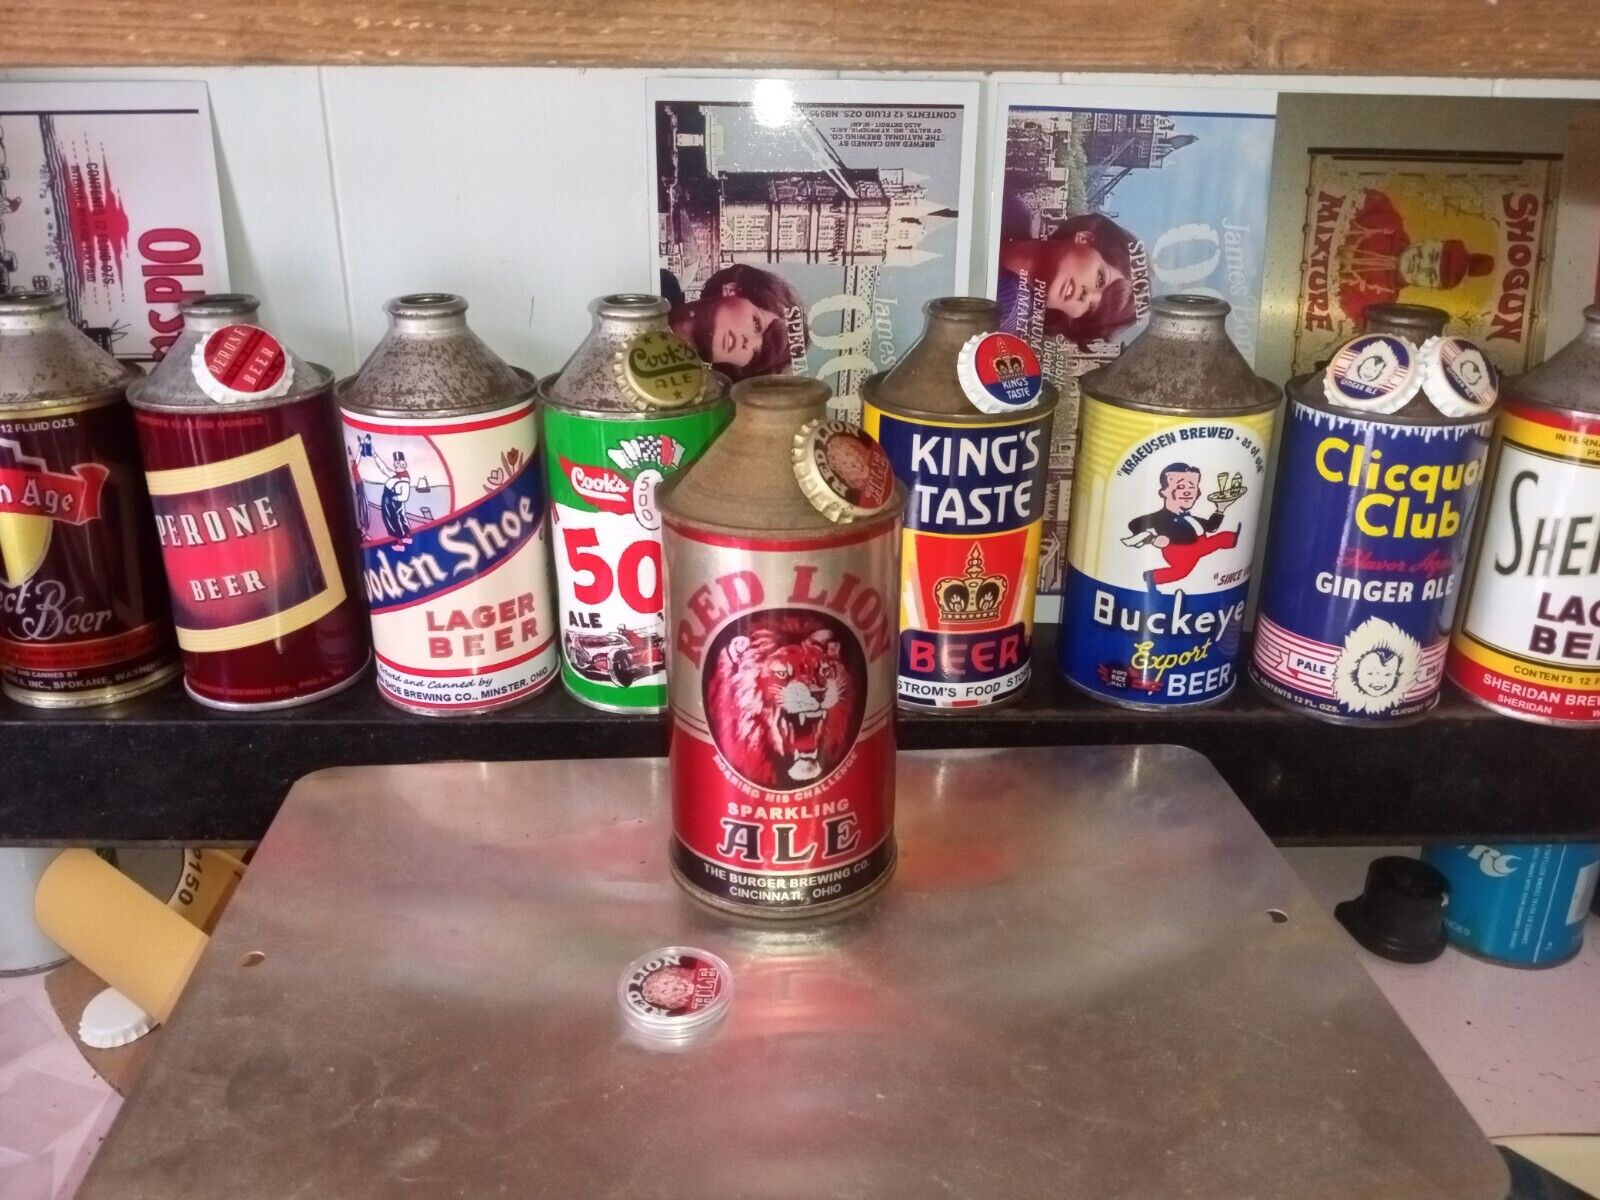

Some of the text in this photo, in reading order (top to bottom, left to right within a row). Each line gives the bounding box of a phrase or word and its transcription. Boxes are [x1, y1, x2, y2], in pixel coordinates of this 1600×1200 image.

[906, 111, 957, 119] CONTENTS
[86, 162, 105, 216] CONTENTS
[138, 228, 206, 303] Old
[1018, 268, 1029, 291] and
[1304, 190, 1347, 333] MIXTURE
[1485, 191, 1539, 343] SHOGUN
[1222, 216, 1258, 353] James Bon
[874, 297, 898, 366] James
[1031, 278, 1047, 348] PREMIUM
[208, 327, 249, 375] PERONE
[243, 347, 275, 386] BEER
[654, 373, 693, 390] ALE
[1006, 387, 1031, 401] TASTE
[1340, 378, 1367, 392] GINGER
[0, 424, 13, 433] 12
[15, 421, 50, 433] FLUID
[1178, 426, 1235, 441] BREWED
[1241, 437, 1252, 449] as
[1250, 446, 1261, 458] of
[911, 429, 1042, 477] KING'S
[1314, 437, 1484, 504] Clicquo
[21, 478, 74, 514] Age
[571, 466, 631, 502] Cook's
[154, 496, 280, 547] PERONE
[915, 480, 1033, 526] TASTE
[1355, 492, 1461, 540] Club
[1495, 470, 1600, 577] SHE
[363, 495, 535, 604] ooden Shoe
[188, 568, 267, 602] BEER
[562, 527, 665, 615] 50
[1315, 571, 1456, 603] GINGER ALE
[8, 579, 113, 640] Beer
[425, 592, 536, 632] LAGER
[568, 610, 604, 630] ALE
[676, 570, 766, 671] RED
[787, 565, 890, 672] LION
[1094, 588, 1246, 641] Buckeye
[428, 617, 539, 659] BEER
[909, 633, 1021, 675] BEER
[1111, 674, 1127, 682] RICE
[1131, 637, 1213, 683] Export
[1296, 658, 1327, 675] PALE
[1513, 665, 1573, 684] CONTENTS
[1580, 677, 1591, 685] 12
[53, 677, 112, 690] SPOKANE,
[403, 678, 424, 688] and
[427, 679, 476, 690] Canned
[478, 676, 494, 688] by
[403, 688, 452, 702] BREWING
[529, 666, 548, 683] OHIO
[965, 681, 1001, 697] FOOD
[1166, 661, 1232, 697] BEER
[1259, 676, 1292, 700] CONTENTS
[1293, 694, 1304, 704] 12
[1304, 699, 1318, 708] FL.
[1483, 673, 1561, 704] SHERIDAN
[1497, 693, 1552, 714] SHERIDAN
[712, 752, 859, 804] ROARING HIS CHALLENGE
[727, 798, 850, 821] SPARKLING
[716, 812, 862, 865] ALE
[703, 860, 871, 889] THE BURGER BREWING CO.
[812, 883, 842, 898] OHIO
